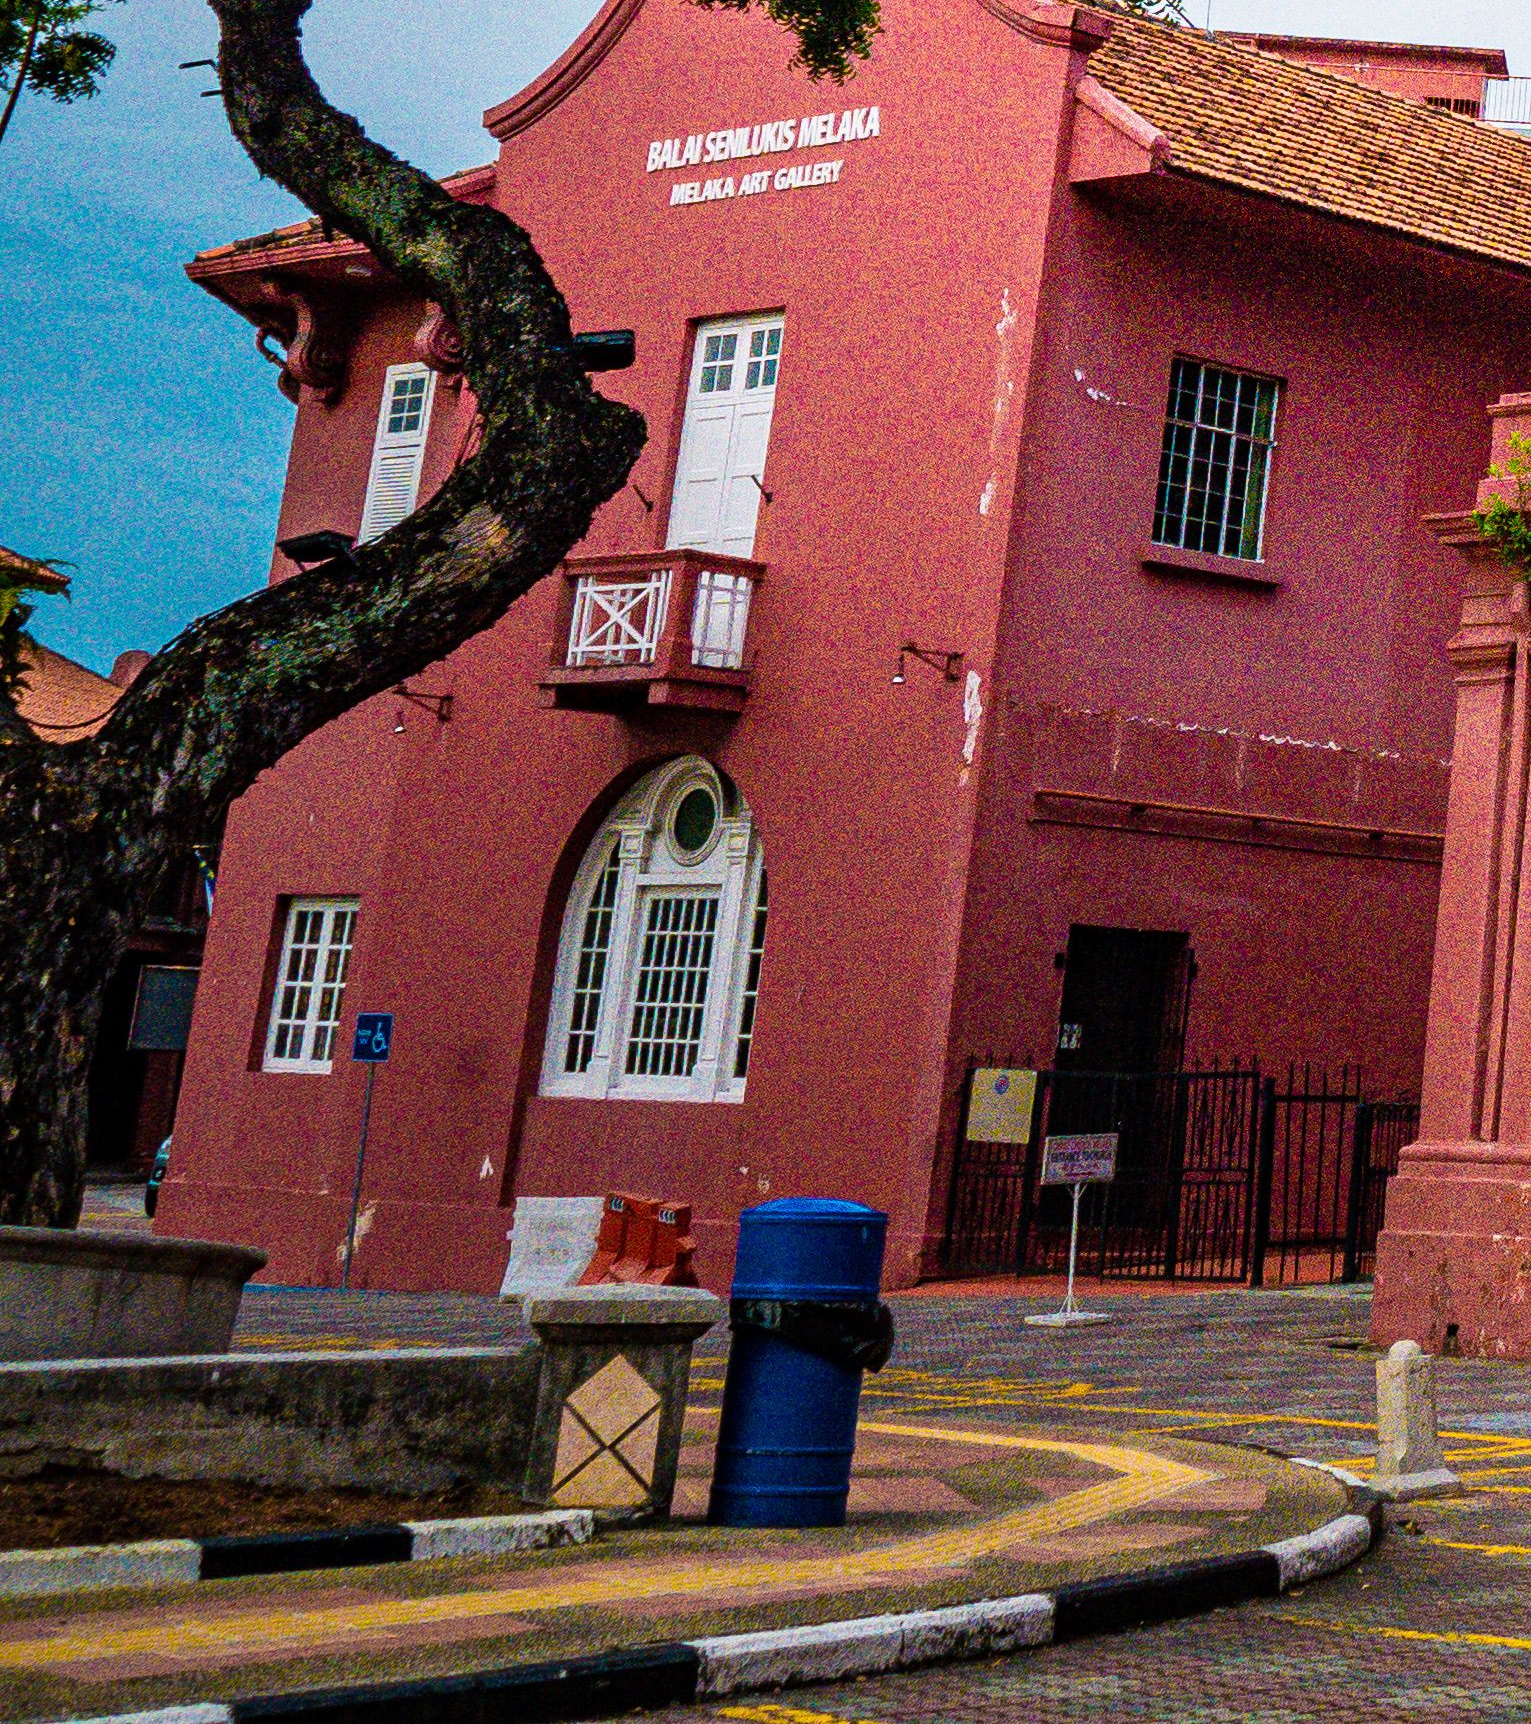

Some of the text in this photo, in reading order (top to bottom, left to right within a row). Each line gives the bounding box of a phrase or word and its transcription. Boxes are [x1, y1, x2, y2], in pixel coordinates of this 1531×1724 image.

[646, 133, 704, 172] BALAI
[797, 105, 881, 149] MELAKA
[669, 159, 844, 206] MELAKA ART GALLERY
